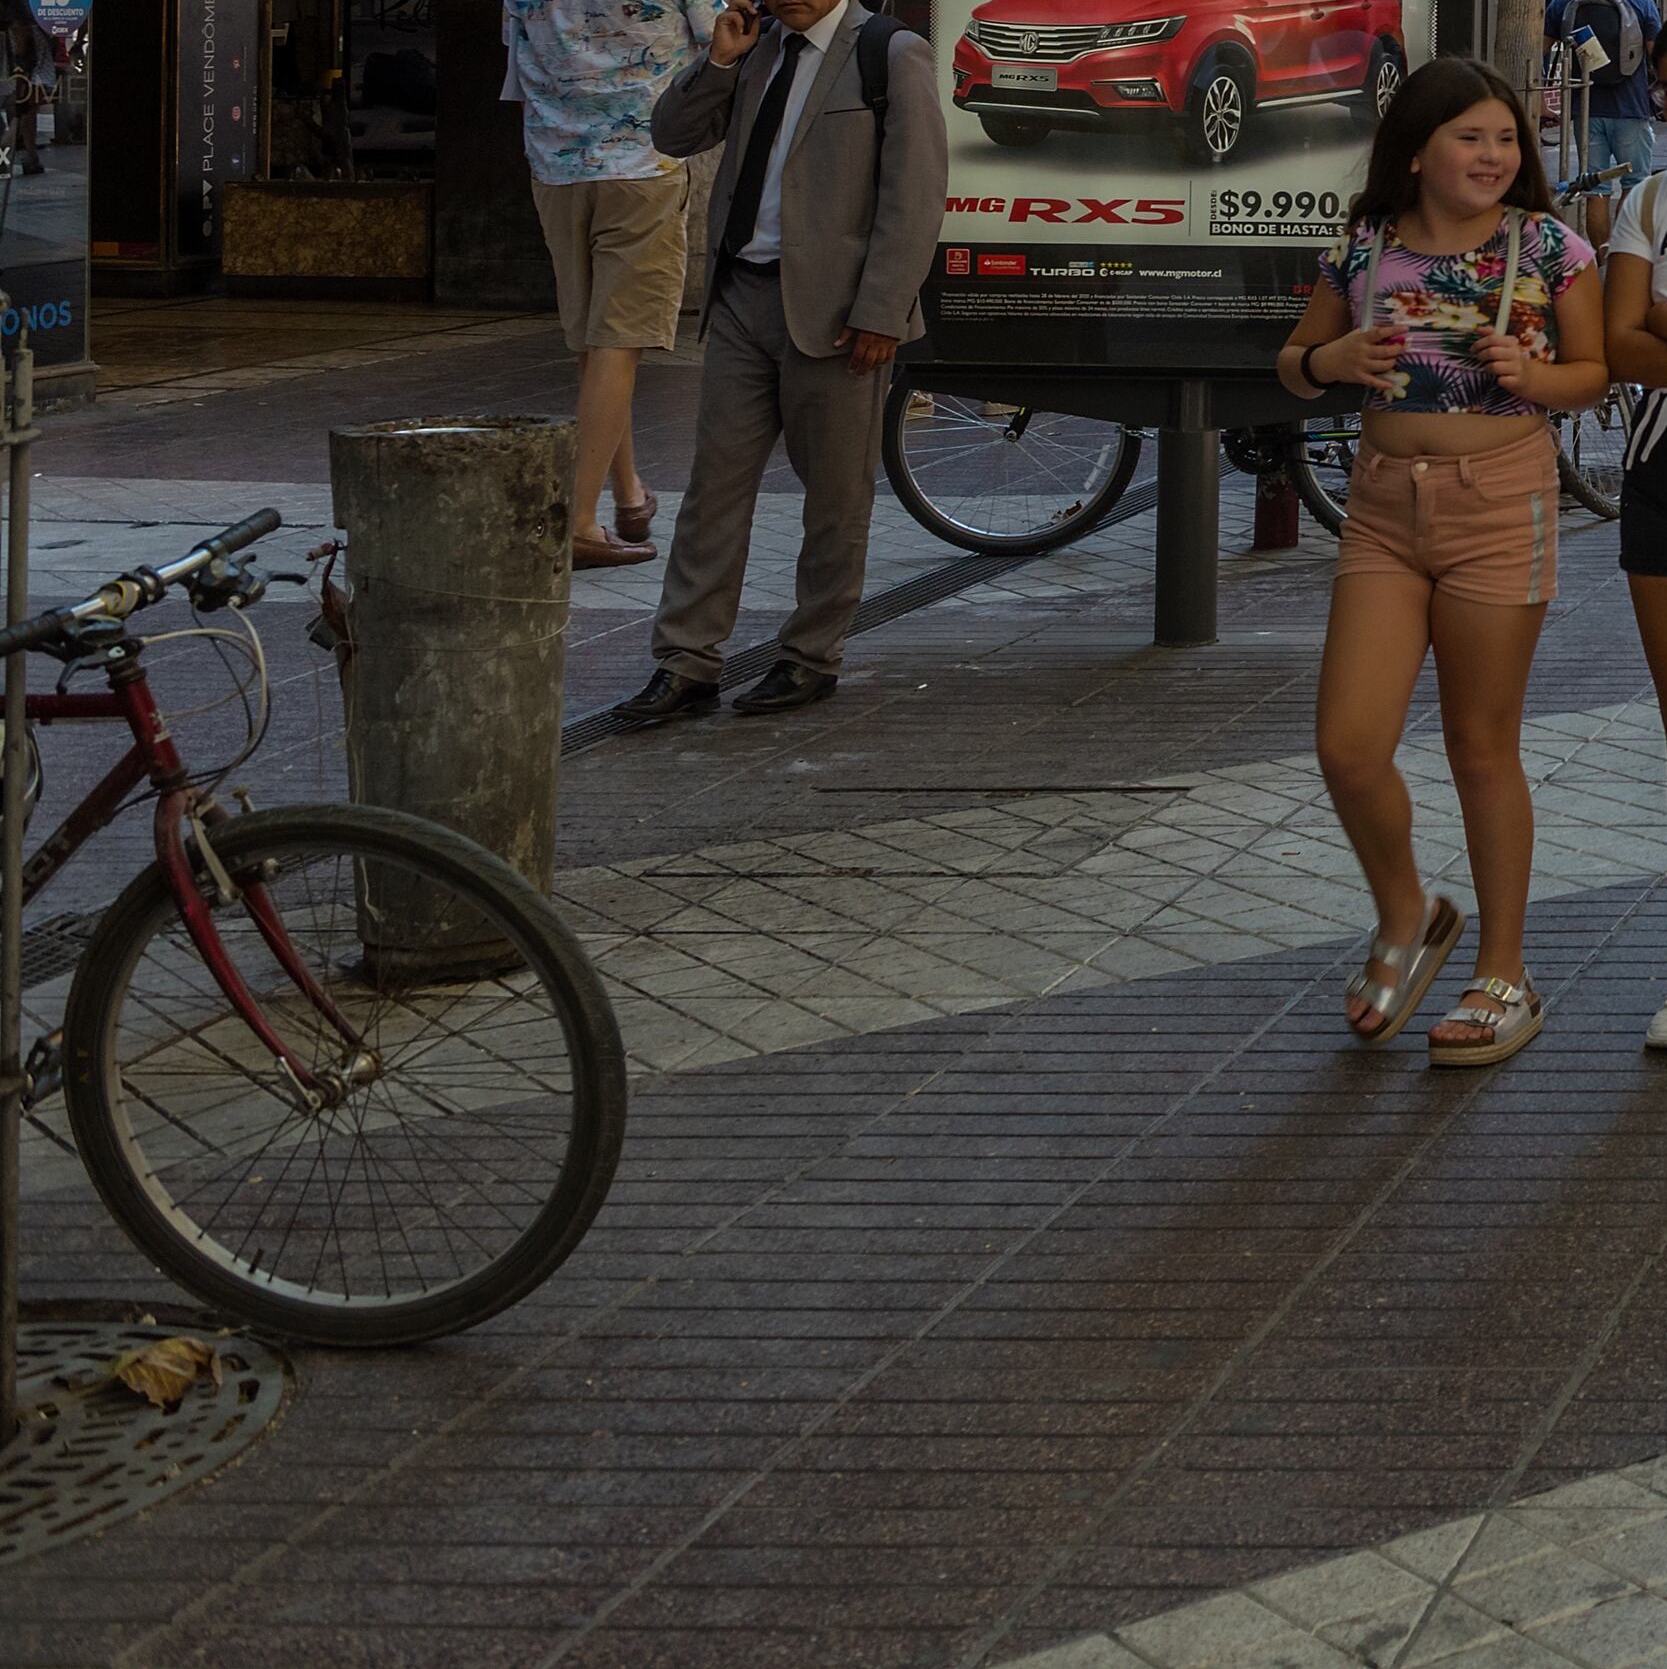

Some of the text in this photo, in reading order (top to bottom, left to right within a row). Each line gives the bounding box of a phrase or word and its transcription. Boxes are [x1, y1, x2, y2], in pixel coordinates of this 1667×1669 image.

[37, 6, 84, 17] DE DESCUENTO
[203, 102, 216, 172] PLACE
[1211, 223, 1255, 235] BONO
[1258, 224, 1277, 235] DE
[1280, 225, 1333, 236] HASTA:
[1030, 267, 1095, 277] TURBO
[1139, 268, 1223, 280] www.mgmotor.cl
